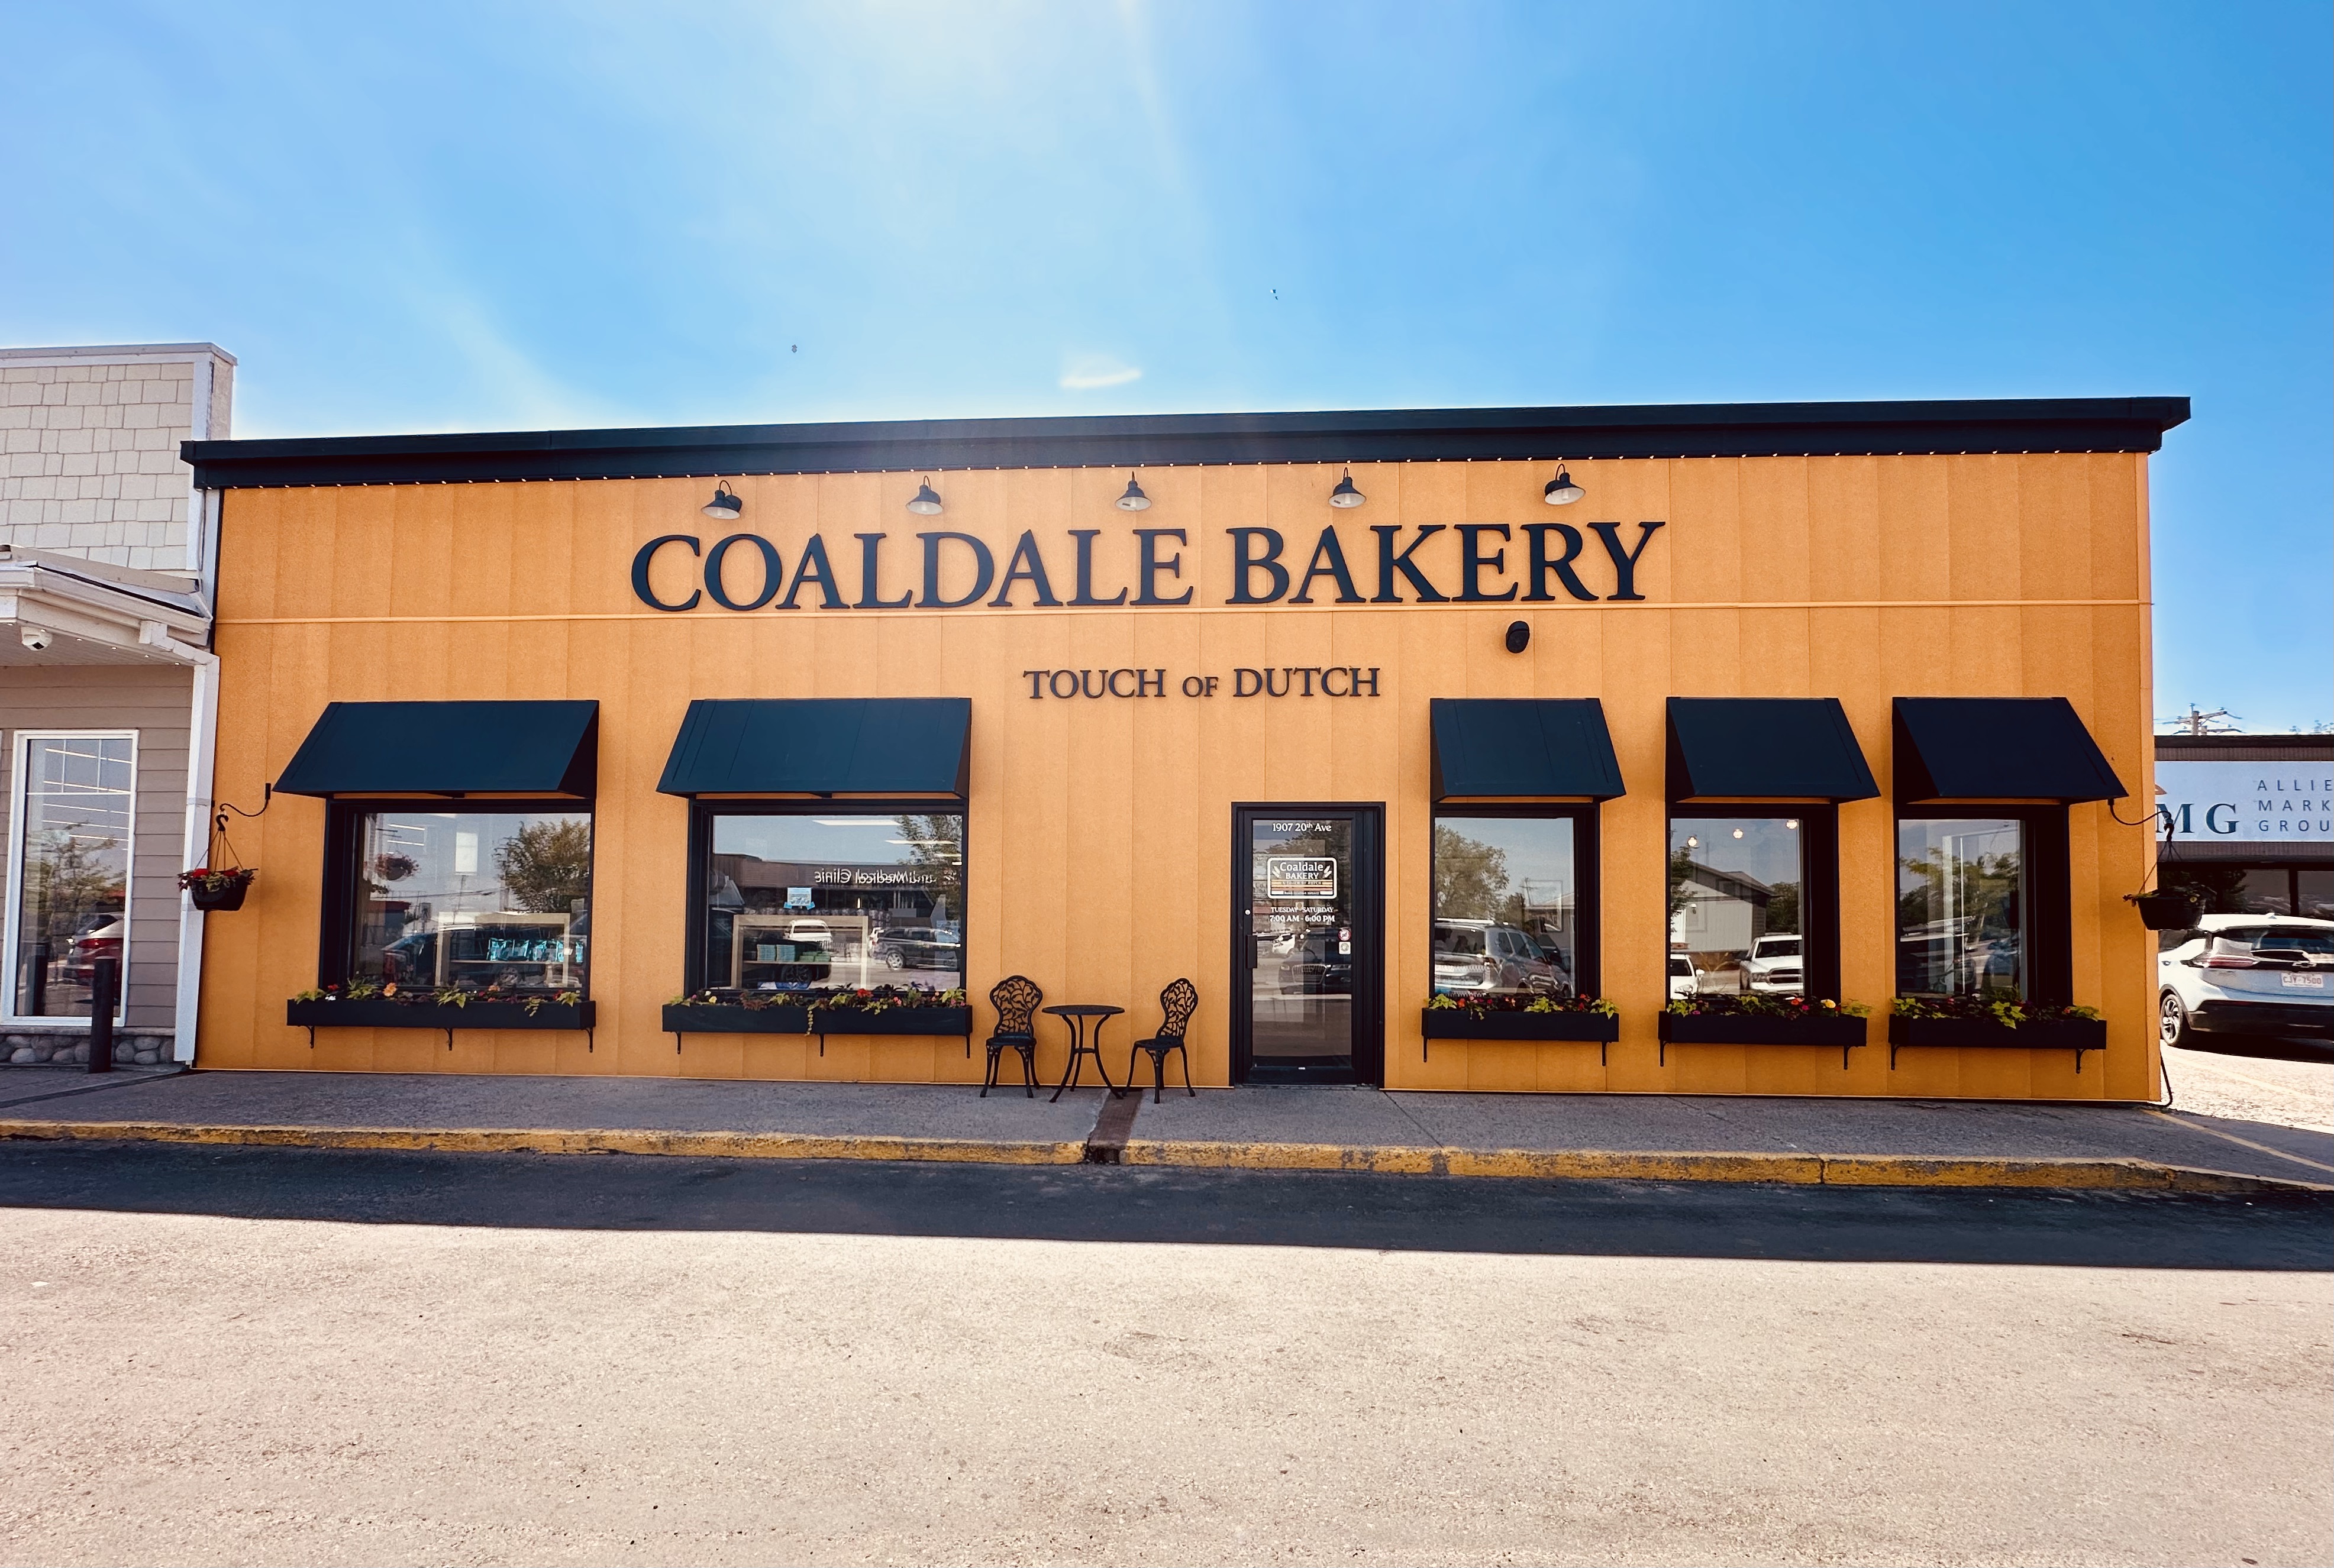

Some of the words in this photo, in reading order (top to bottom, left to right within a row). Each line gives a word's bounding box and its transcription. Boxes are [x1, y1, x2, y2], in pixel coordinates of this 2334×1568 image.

[631, 528, 1194, 612] COALDALE
[1225, 521, 1665, 604] BAKERY
[1023, 668, 1166, 699] TOUCH
[1182, 676, 1219, 698] OF
[1233, 667, 1381, 697] DUTCH
[2257, 780, 2333, 791] ALLIE
[2258, 800, 2330, 812] MARK
[1273, 823, 1293, 832] 1907
[1294, 822, 1313, 832] 20th
[1314, 823, 1332, 832] Ave
[2258, 820, 2329, 832] GROU
[1280, 862, 1324, 871] Coaldale
